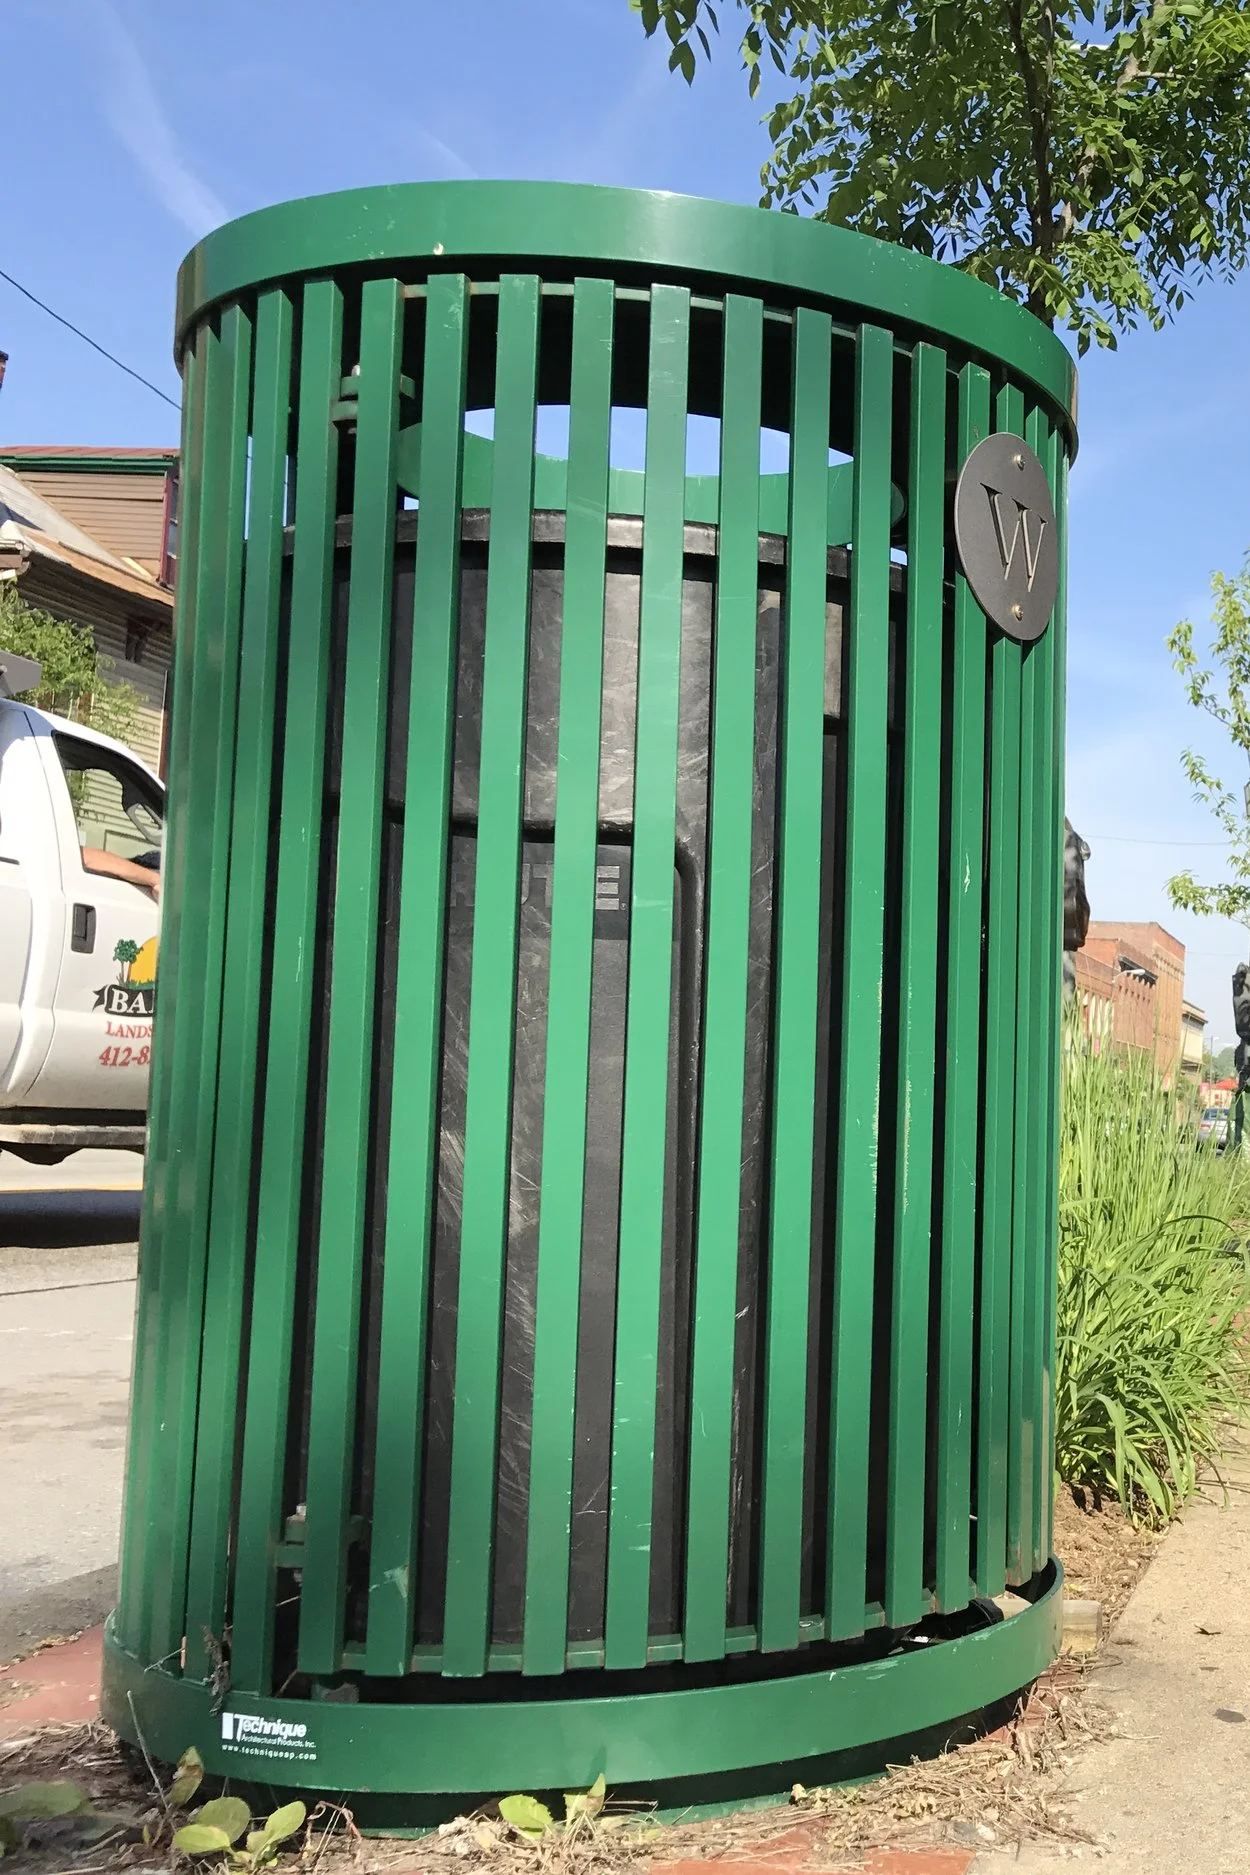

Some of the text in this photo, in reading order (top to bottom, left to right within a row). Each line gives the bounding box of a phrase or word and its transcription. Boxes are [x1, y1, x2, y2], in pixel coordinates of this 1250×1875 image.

[980, 482, 1048, 593] W
[108, 988, 155, 1014] BA
[98, 1045, 151, 1067] 412-8
[234, 1713, 307, 1742] Technique
